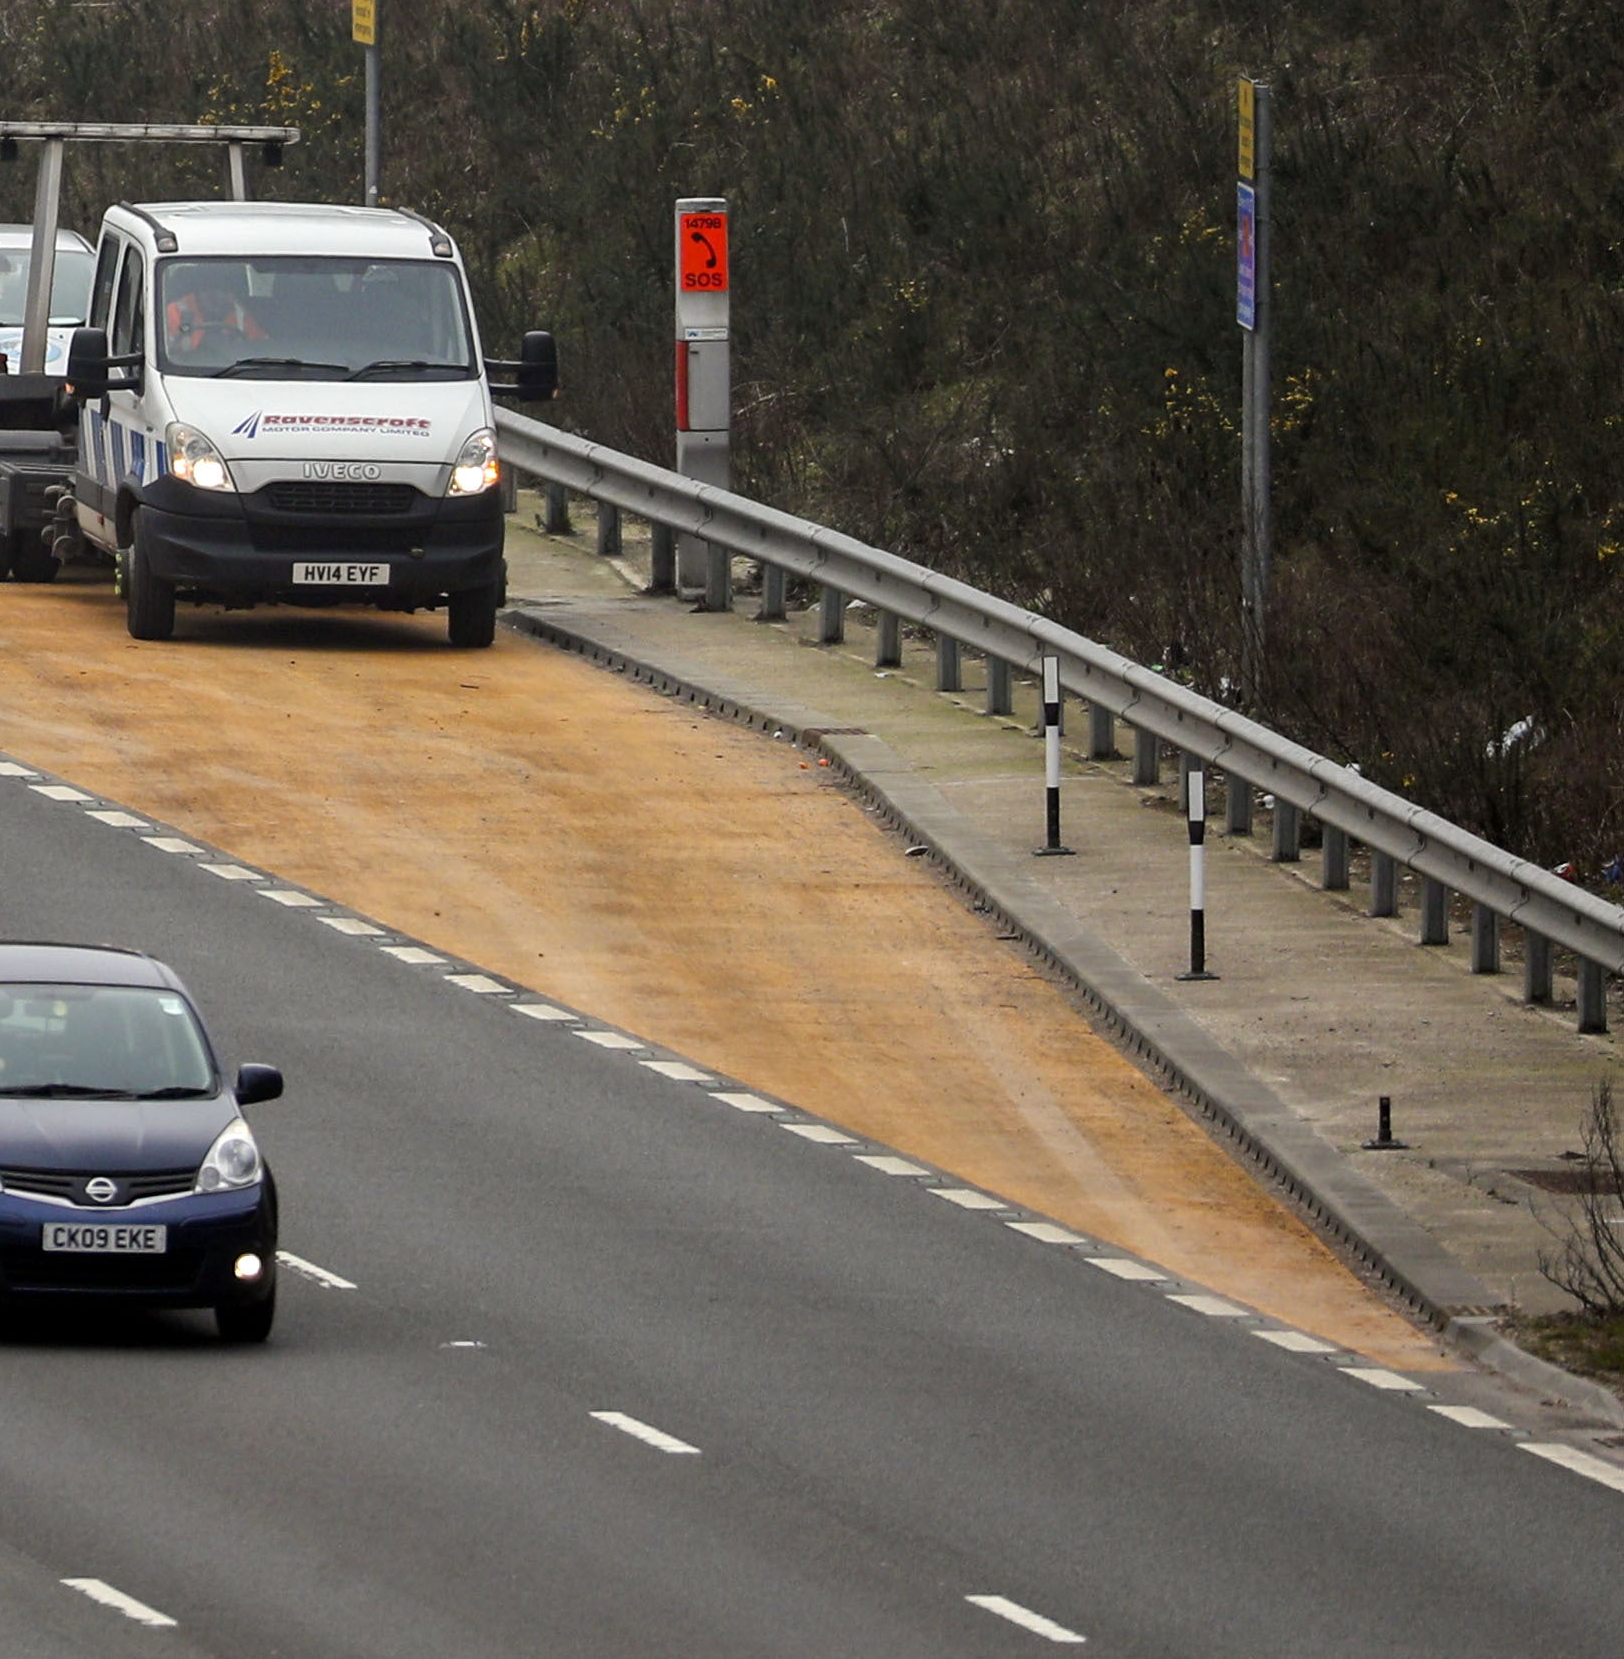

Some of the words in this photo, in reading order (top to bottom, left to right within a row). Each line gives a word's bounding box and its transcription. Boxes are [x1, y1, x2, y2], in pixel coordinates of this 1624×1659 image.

[685, 273, 723, 287] SOS
[262, 414, 432, 429] Ravenscroft
[312, 426, 376, 434] COMPANY
[379, 428, 431, 437] LIMITED
[303, 462, 382, 480] IVECO
[304, 565, 341, 581] HV14
[347, 565, 380, 582] EYF
[53, 1227, 109, 1248] CK09
[115, 1228, 156, 1250] EKE
